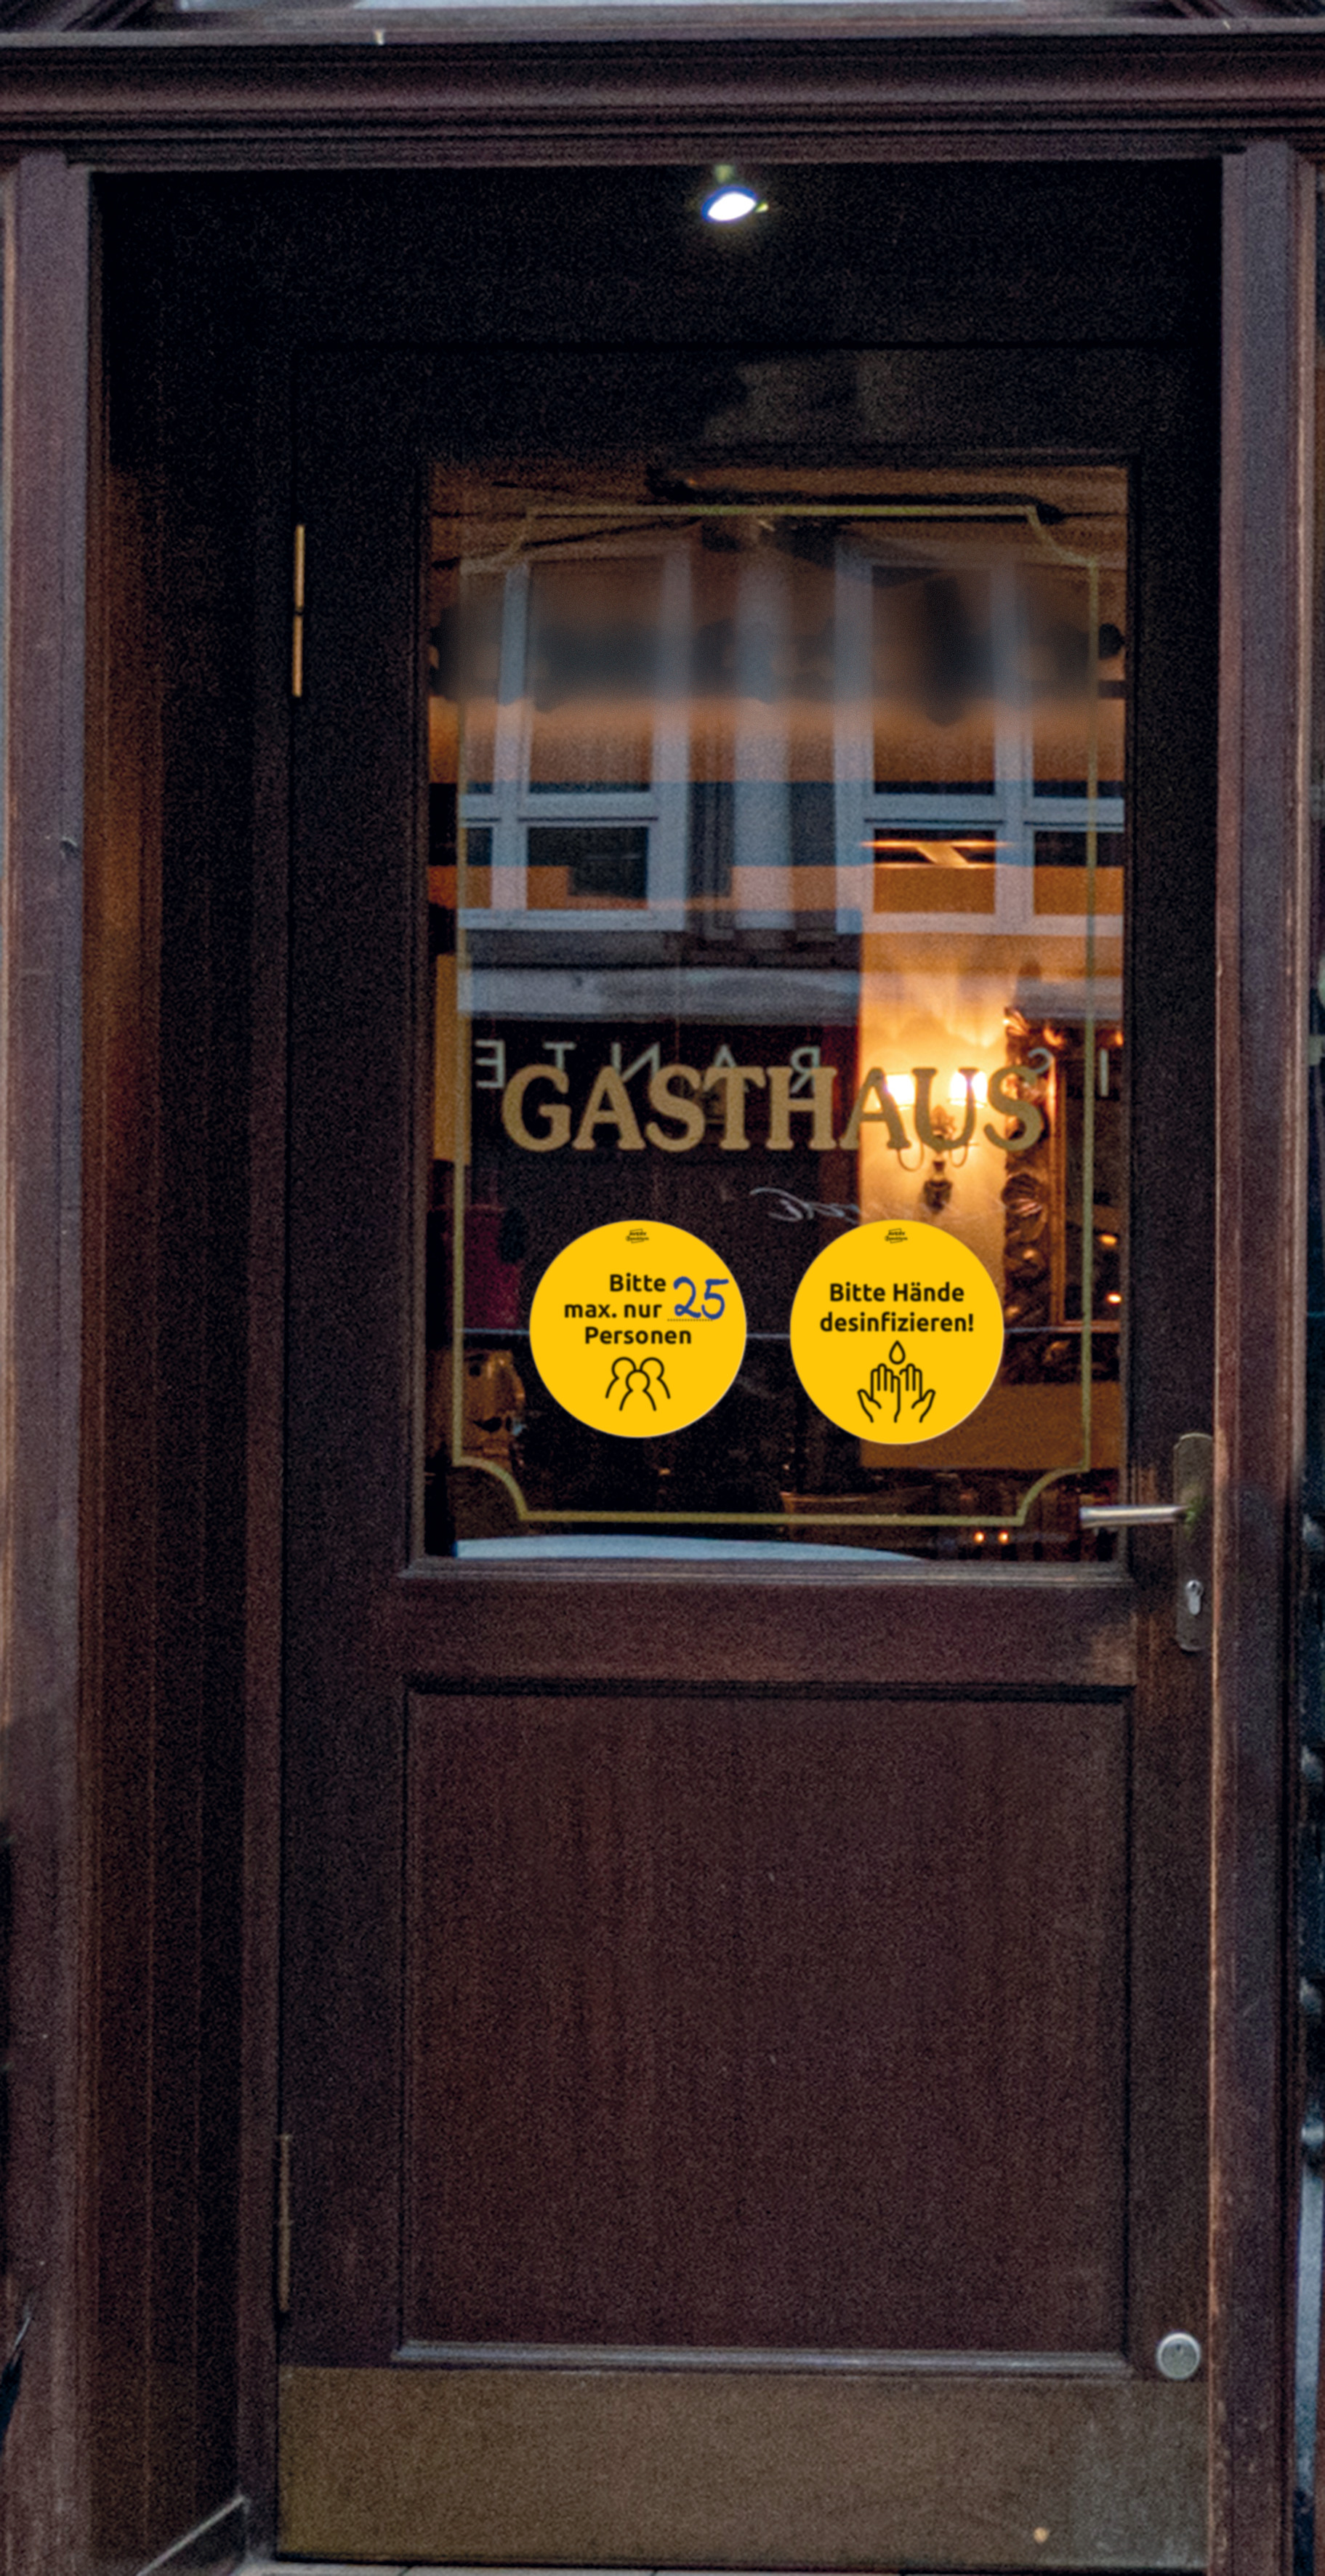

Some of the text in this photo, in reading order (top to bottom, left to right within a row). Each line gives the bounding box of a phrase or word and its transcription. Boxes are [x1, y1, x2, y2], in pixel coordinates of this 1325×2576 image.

[501, 1064, 1044, 1152] GASTHAUS
[610, 1272, 666, 1292] Bitte
[830, 1281, 964, 1302] Bitte Hände
[673, 1276, 729, 1320] 25
[564, 1304, 662, 1318] max. nur
[820, 1311, 974, 1332] desinfizieren!
[585, 1326, 692, 1344] Personen
